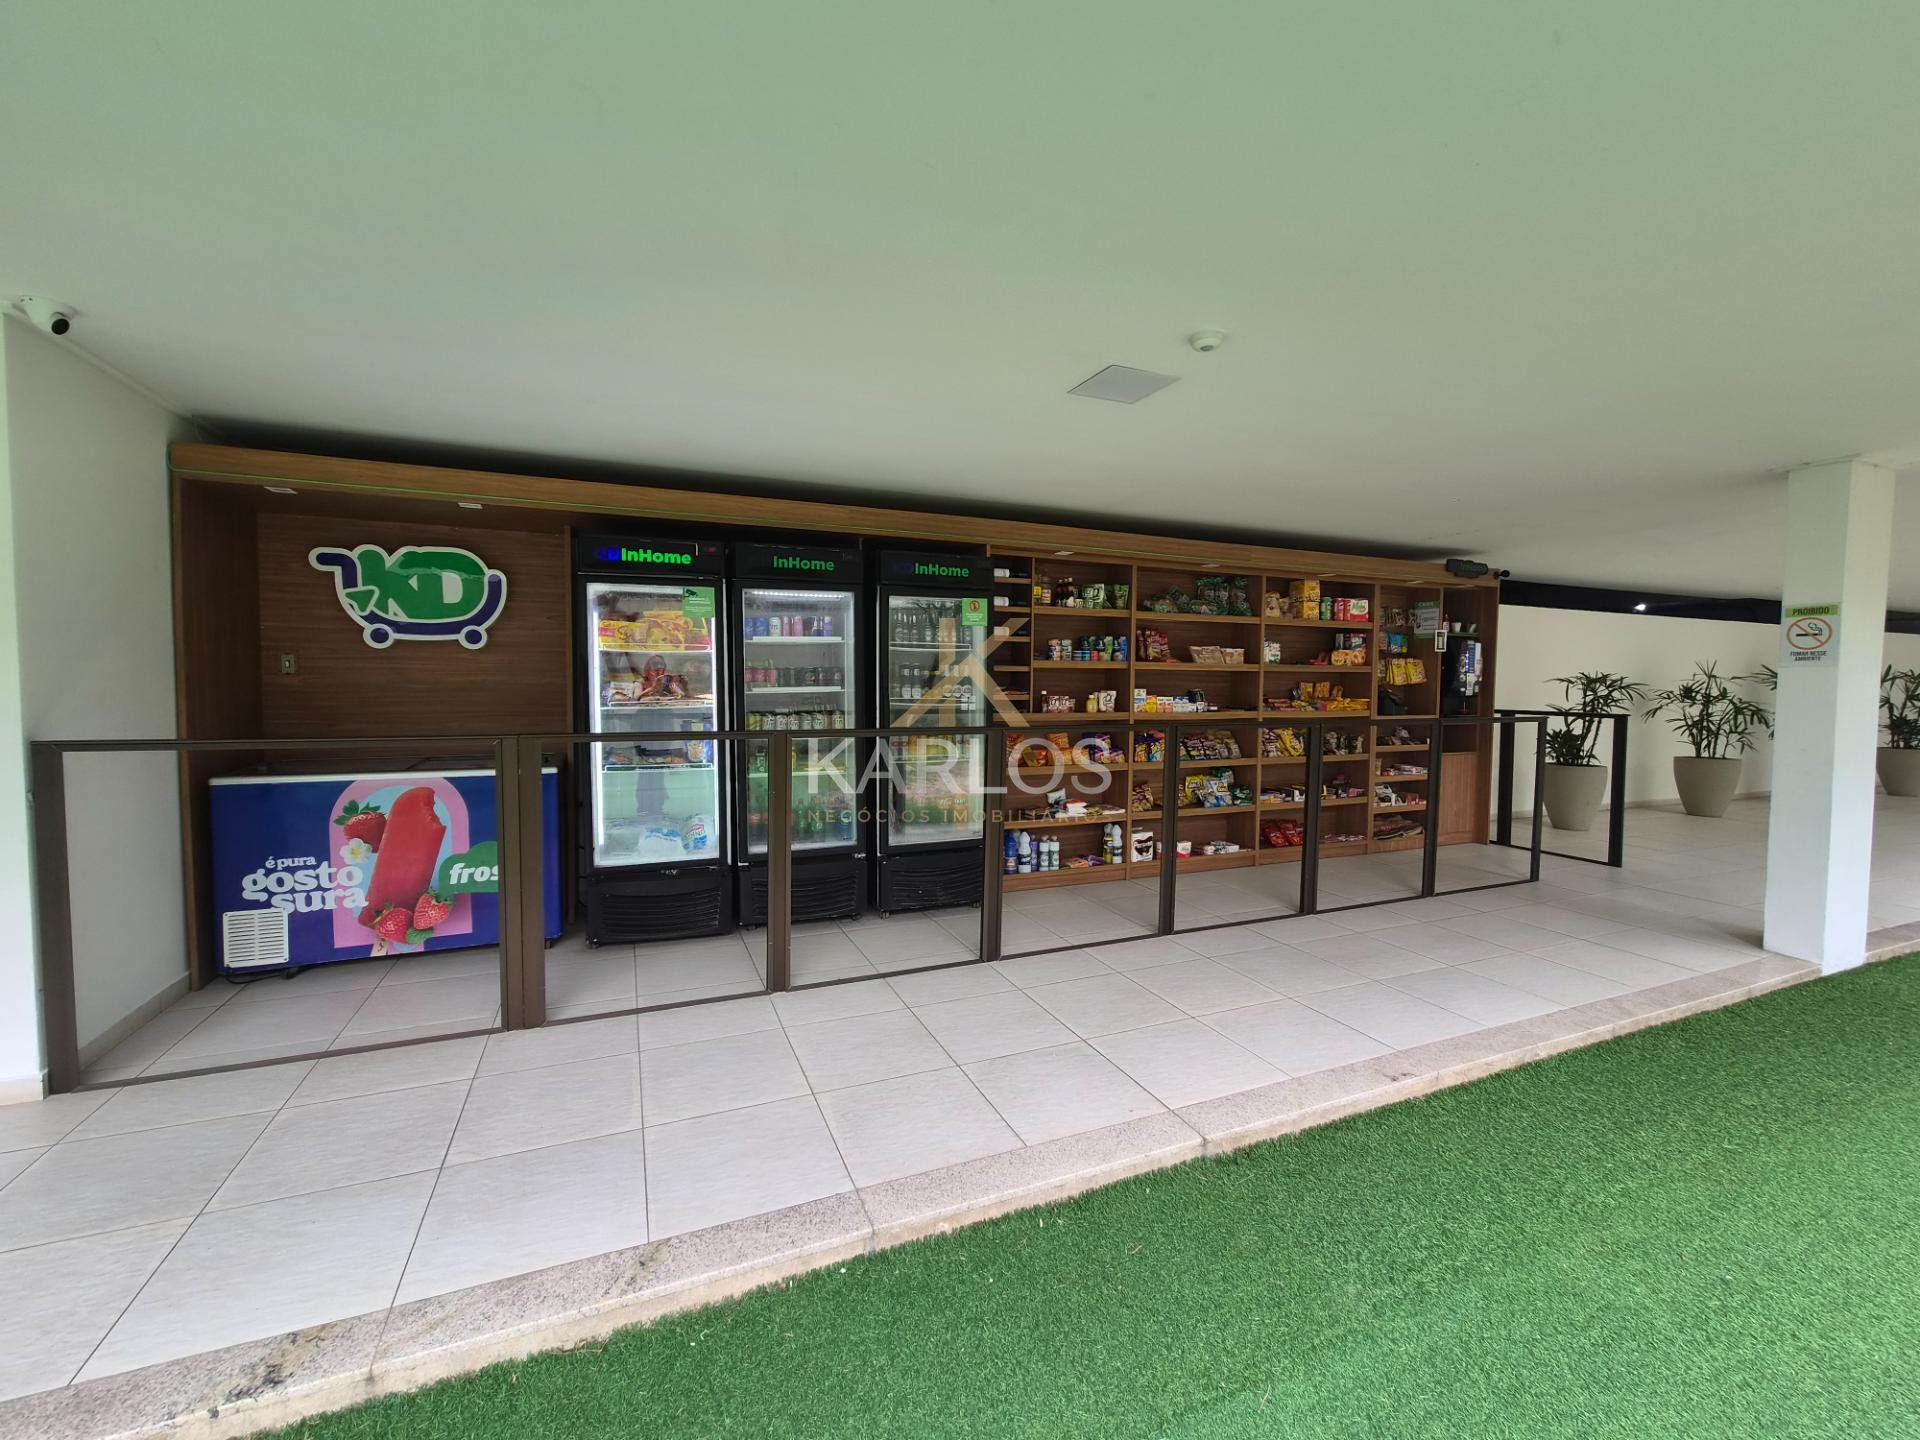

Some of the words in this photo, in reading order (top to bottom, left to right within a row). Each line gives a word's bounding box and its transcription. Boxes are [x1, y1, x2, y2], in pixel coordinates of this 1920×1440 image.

[621, 547, 692, 565] InHome
[773, 555, 835, 571] InHome
[914, 562, 970, 577] InHome
[1792, 606, 1830, 615] PROIBIDO
[265, 856, 276, 868] é
[276, 856, 317, 870] pura
[242, 861, 363, 902] gosto
[271, 887, 369, 914] sura
